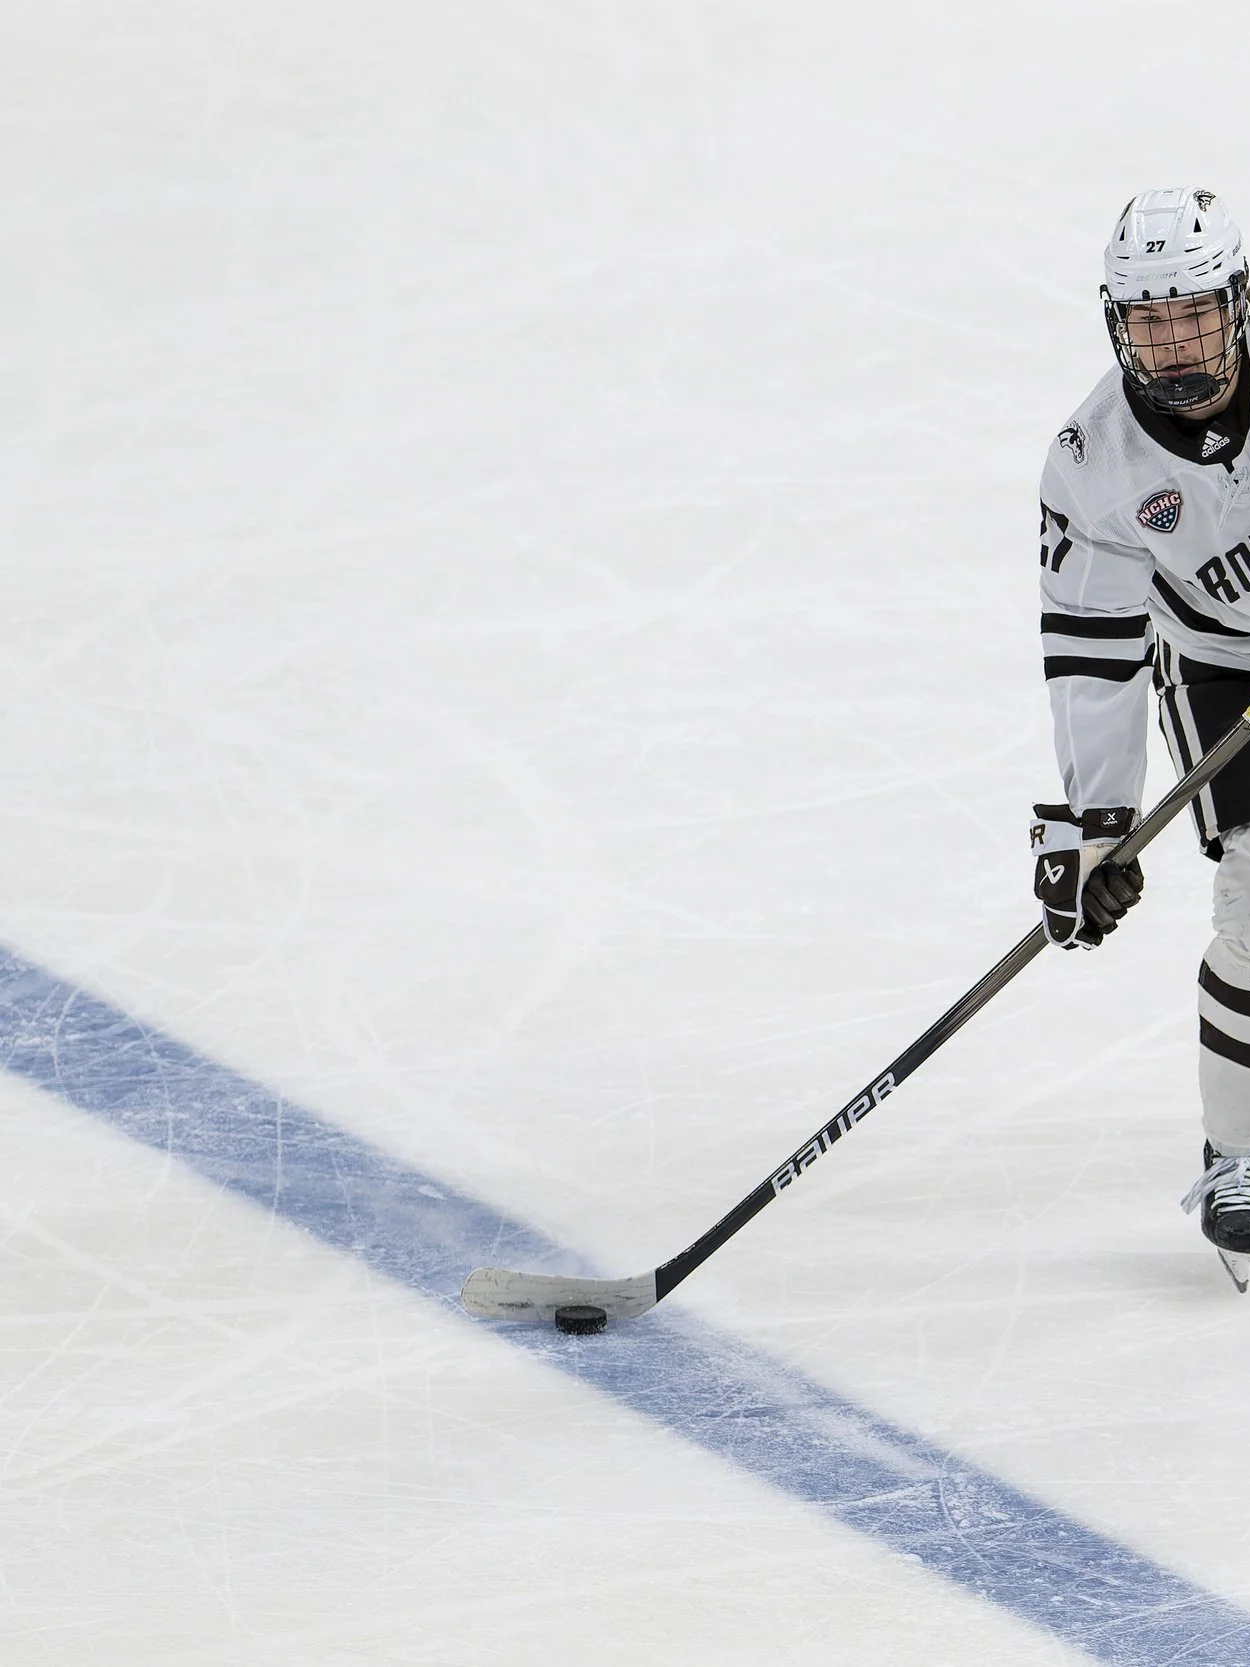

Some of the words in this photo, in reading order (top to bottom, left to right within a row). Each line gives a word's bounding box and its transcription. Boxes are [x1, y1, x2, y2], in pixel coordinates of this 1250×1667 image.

[1145, 240, 1166, 254] 27
[1201, 436, 1231, 458] adidas
[1138, 493, 1181, 524] NCHC
